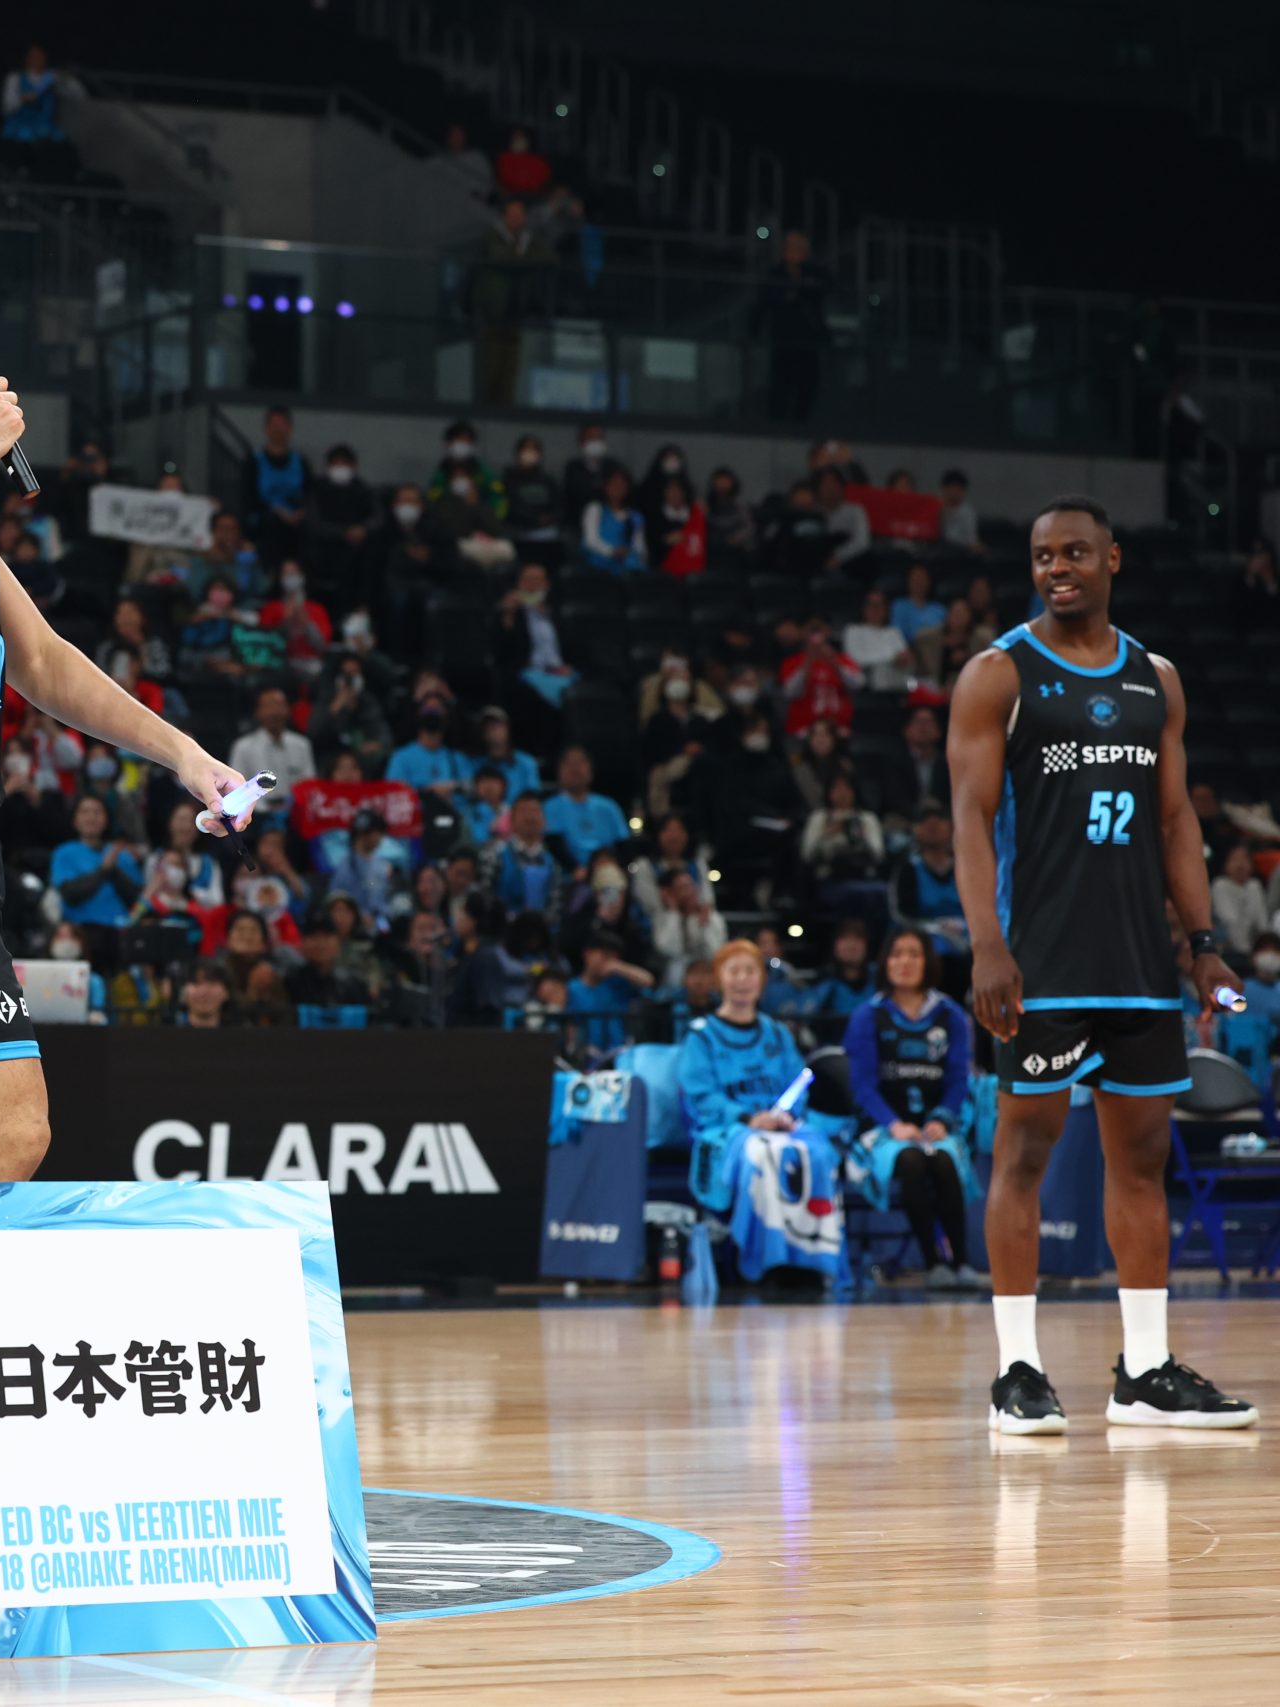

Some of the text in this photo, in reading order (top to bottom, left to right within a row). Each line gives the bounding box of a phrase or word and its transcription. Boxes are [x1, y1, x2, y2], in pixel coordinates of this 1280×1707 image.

[1081, 744, 1158, 767] SEPTEN
[1086, 790, 1135, 845] 52
[133, 1120, 500, 1195] CLARA
[39, 1504, 74, 1546] BC
[79, 1510, 111, 1543] vs
[115, 1499, 232, 1542] VEERTIEN
[237, 1497, 286, 1538] MIE
[30, 1549, 134, 1594] @ARIAKE
